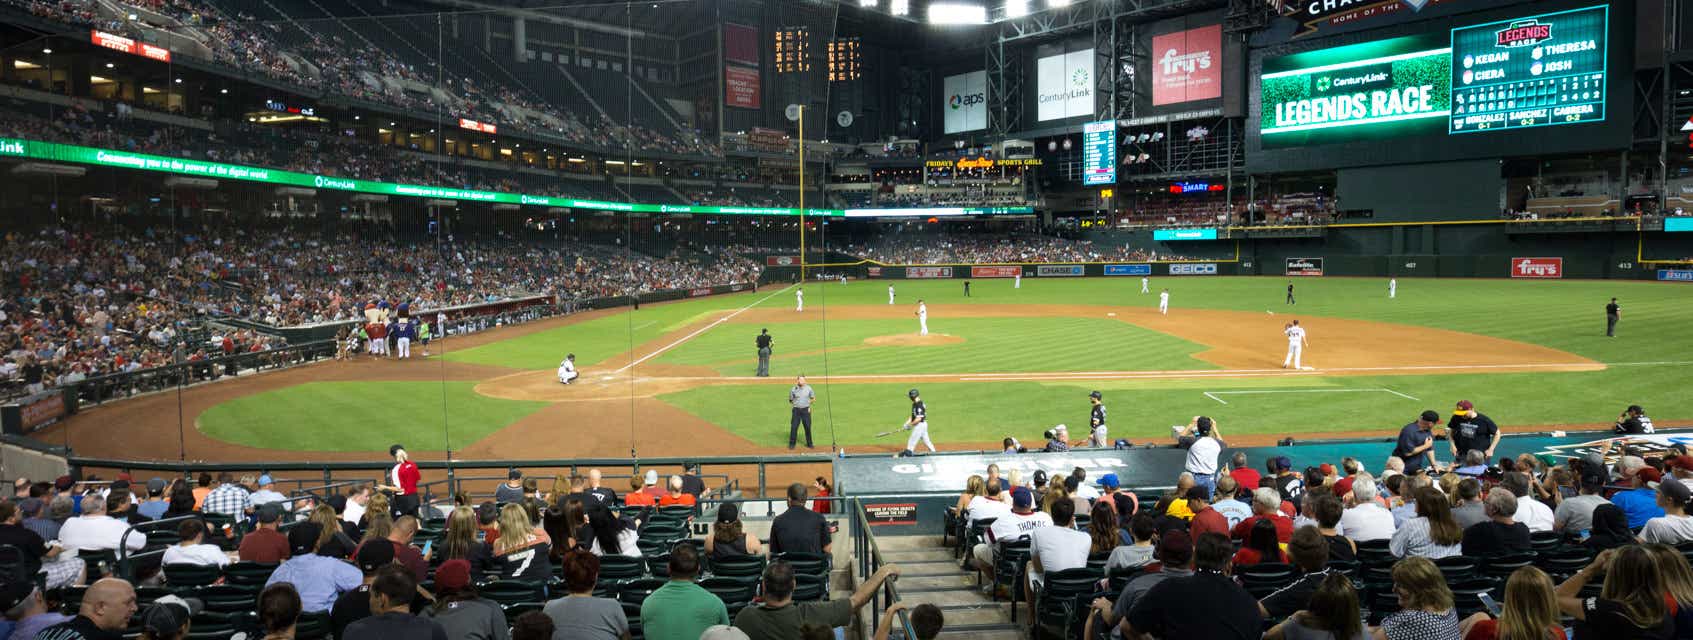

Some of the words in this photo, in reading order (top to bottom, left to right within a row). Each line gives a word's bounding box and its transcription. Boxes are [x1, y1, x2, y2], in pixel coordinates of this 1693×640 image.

[1333, 13, 1358, 24] HOME
[1382, 3, 1399, 12] THE
[1499, 26, 1548, 44] LEGENDS
[1158, 48, 1211, 75] fry's
[1475, 52, 1510, 64] KEGAN
[1545, 40, 1596, 56] THERESA
[1334, 72, 1387, 87] CenturyLink
[1475, 68, 1505, 80] CIERA
[1544, 60, 1572, 72] JOSH
[964, 92, 986, 108] aps
[1040, 88, 1090, 104] CenturyLink
[1276, 92, 1367, 126] LEGENDS
[1372, 84, 1433, 116] RACE
[1466, 113, 1504, 124] GONZALEZ
[1510, 109, 1547, 120] SANCHEZ
[1554, 104, 1593, 116] CABRERA
[97, 150, 145, 168] Connecting
[146, 158, 160, 169] you
[162, 160, 170, 169] to
[171, 160, 183, 170] the
[185, 163, 208, 173] power
[209, 165, 216, 174] of
[217, 166, 227, 175] the
[228, 167, 248, 178] digital
[324, 178, 355, 189] CenturyLink
[528, 196, 549, 204] CenturyLink
[1172, 265, 1215, 274] GEICO
[1517, 260, 1556, 275] fry's
[508, 548, 535, 577] 7
